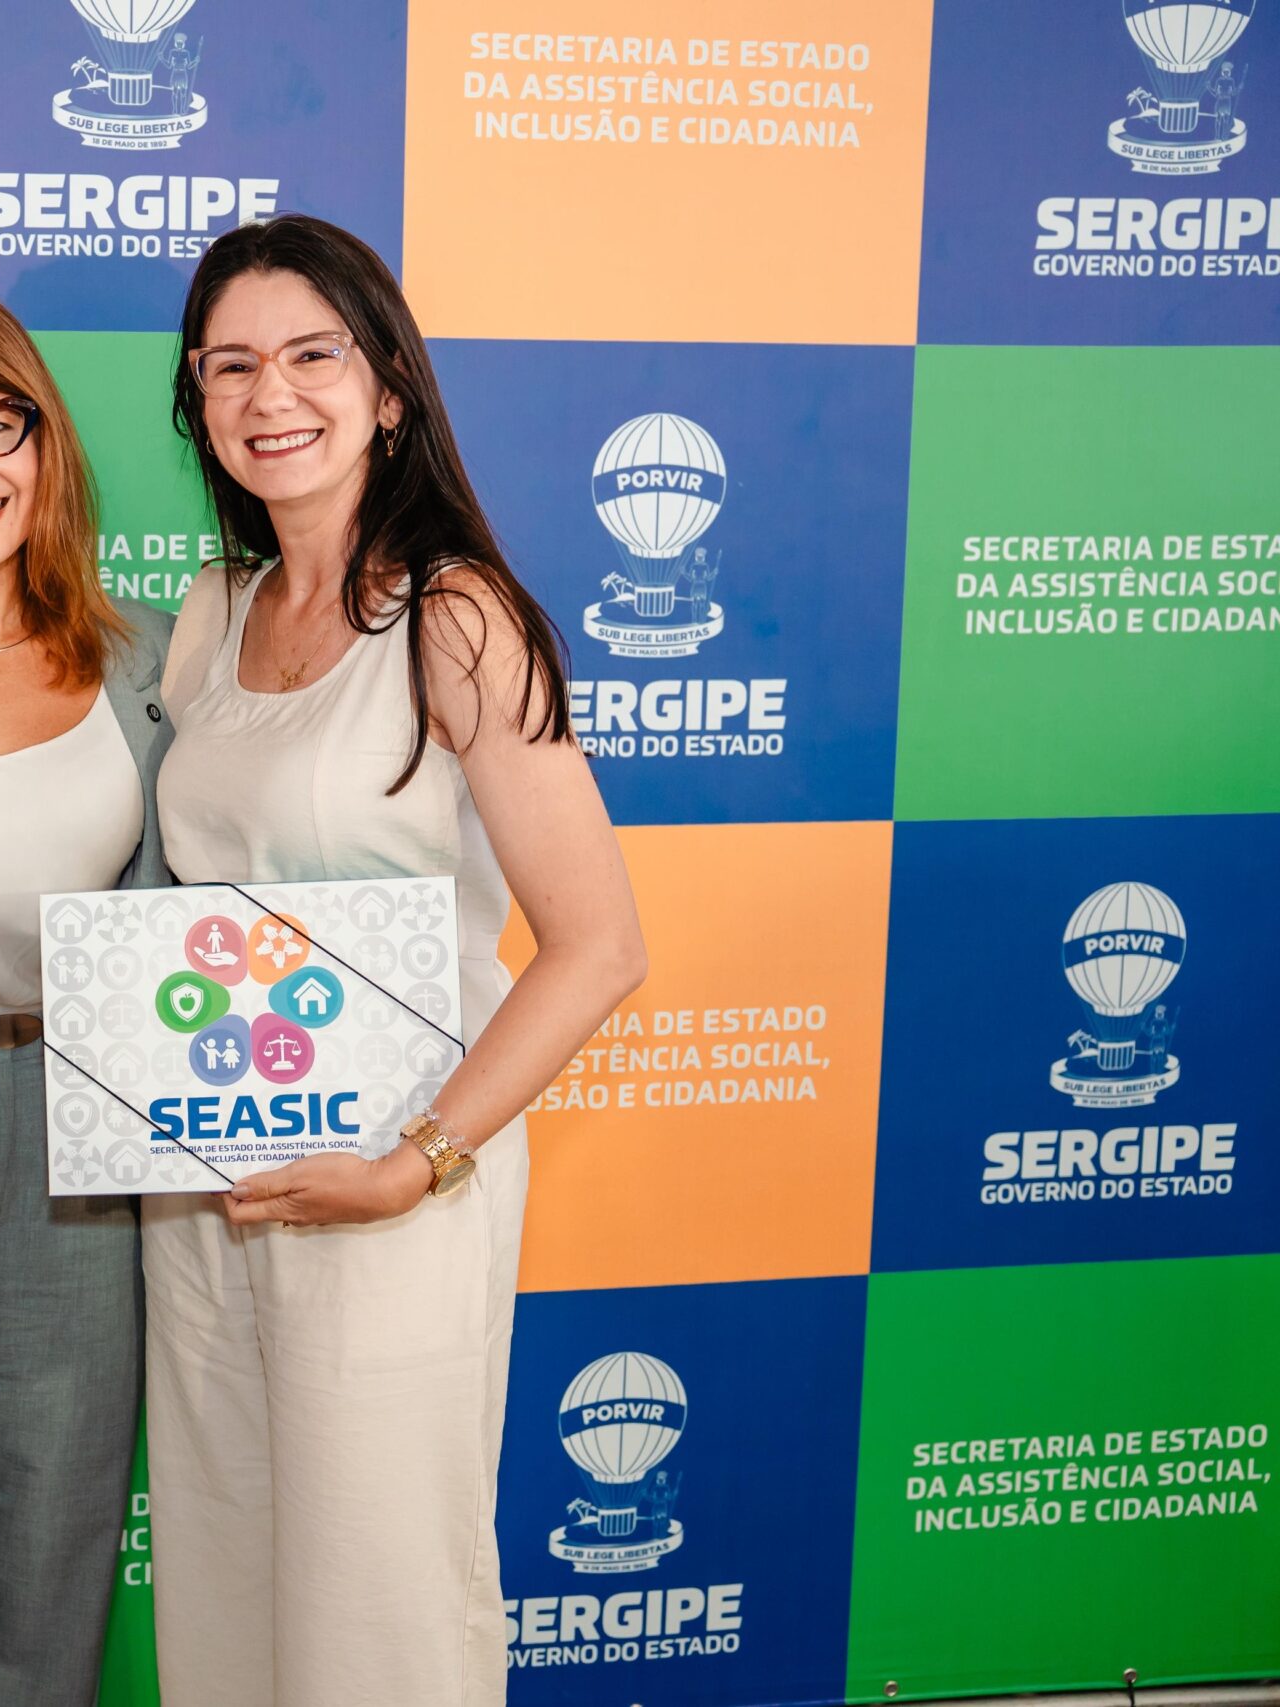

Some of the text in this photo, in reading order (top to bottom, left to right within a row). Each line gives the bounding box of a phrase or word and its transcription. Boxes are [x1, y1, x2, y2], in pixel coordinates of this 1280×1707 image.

[470, 32, 869, 71] SECRETARIA DE ESTADO
[464, 70, 873, 114] DA ASSISTÊNCIA SOCIAL,
[68, 116, 192, 134] SUB LEGE LIBERTAS
[475, 109, 860, 147] INCLUSÃO E CIDADANIA
[1121, 144, 1232, 160] SUB LEGE LIBERTAS
[121, 235, 161, 257] DO
[1033, 254, 1280, 276] GOVERNO DO ESTAD
[617, 470, 703, 492] PORVIR
[143, 534, 187, 560] DE
[964, 534, 1280, 561] SECRETARIA DE ESTA
[956, 573, 999, 598] DA
[1007, 566, 1209, 598] ASSISTÊNCIA
[966, 603, 1280, 634] INCLUSÃO E CIDADAN
[598, 627, 709, 643] SUB LEGE LIBERTAS
[567, 679, 787, 732] ERGIPE
[642, 735, 678, 757] DO
[685, 734, 783, 756] ESTADO
[1085, 934, 1164, 955] PORVIR
[654, 1010, 694, 1036] DE
[703, 1005, 826, 1034] ESTADO
[561, 1041, 830, 1075] STÊNCIA SOCIAL,
[618, 1083, 636, 1108] E
[645, 1076, 817, 1107] CIDADANIA
[149, 1092, 360, 1140] SEASIC
[150, 1141, 362, 1154] SECRETARIA DE ESTADO DA ASSISTÊNCIA SOCIAL,
[206, 1153, 249, 1163] INCLUSÃO
[258, 1153, 305, 1161] CIDADANIA
[983, 1123, 1237, 1183] SERGIPE
[981, 1174, 1232, 1204] GOVERNO DO ESTADO
[582, 1403, 664, 1425] PORVIR
[913, 1424, 1268, 1467] SECRETARIA DE ESTADO
[906, 1458, 1271, 1500] DA ASSISTÊNCIA SOCIAL,
[915, 1491, 1258, 1532] INCLUSÃO E CIDADANIA
[507, 1633, 740, 1670] VERNO DO ESTADO
